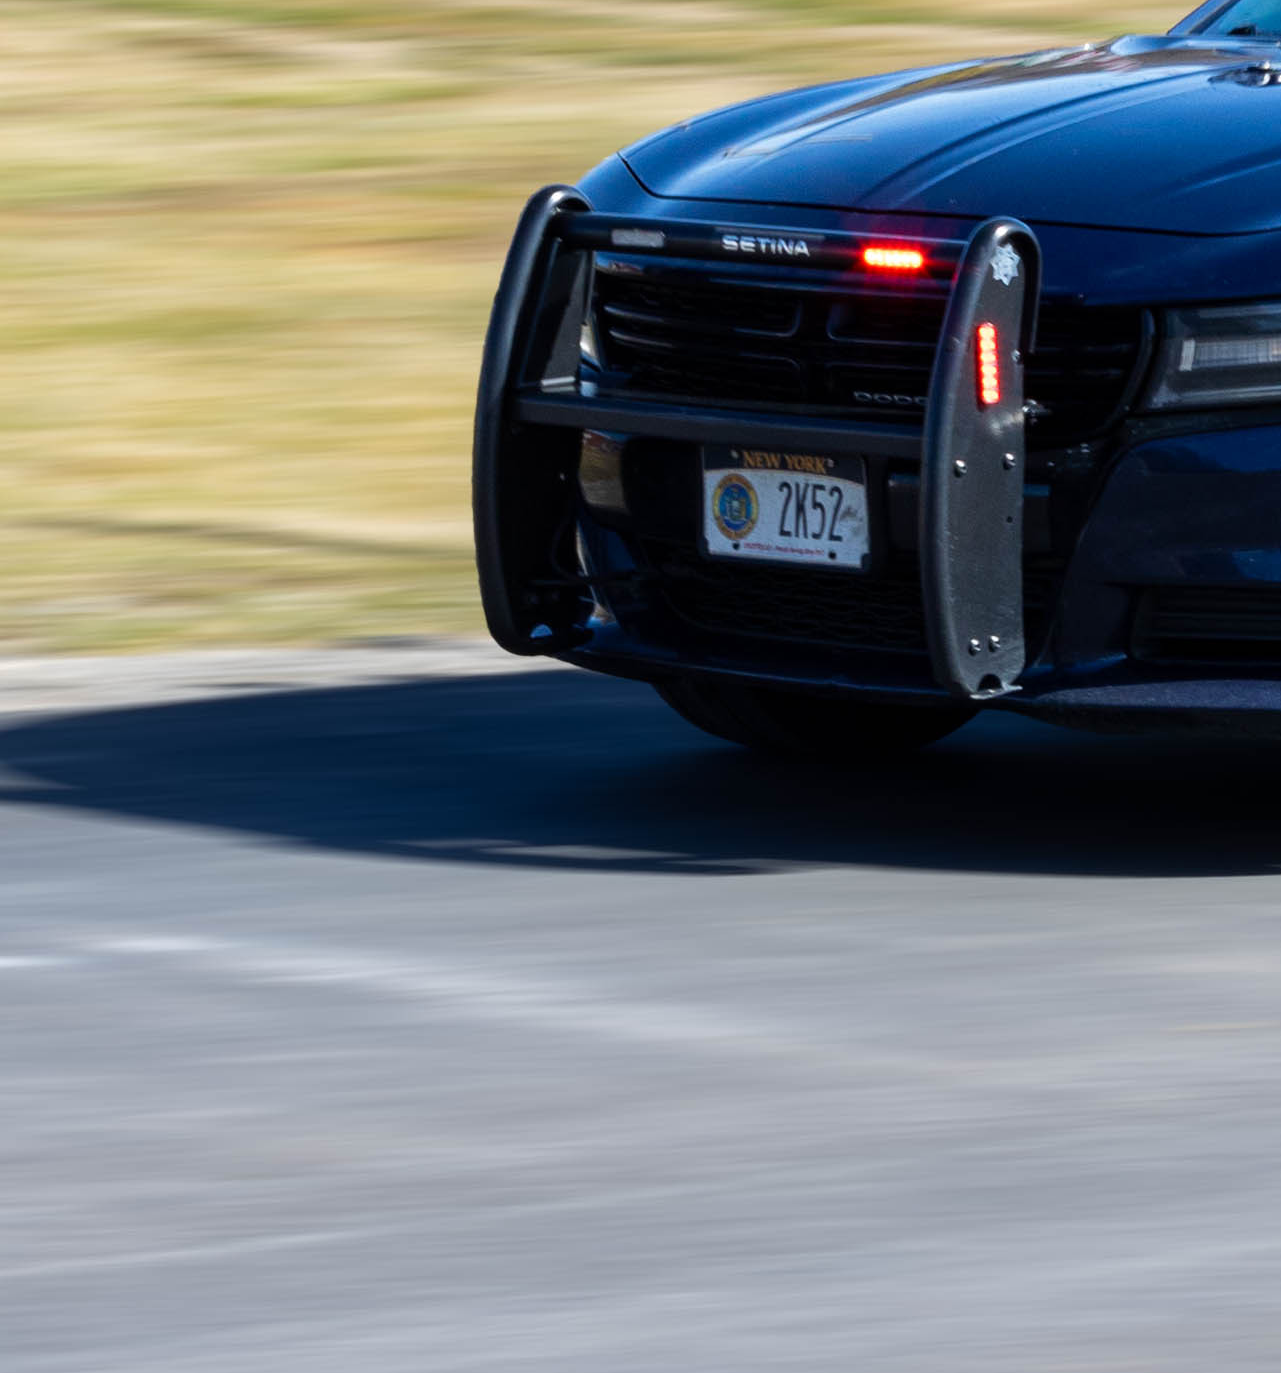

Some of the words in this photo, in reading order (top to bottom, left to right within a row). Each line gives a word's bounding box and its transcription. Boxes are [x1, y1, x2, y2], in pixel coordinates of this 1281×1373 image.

[721, 234, 810, 257] SETINA
[743, 451, 781, 469] NEW
[784, 453, 827, 475] YORK
[778, 481, 843, 542] 2K52
